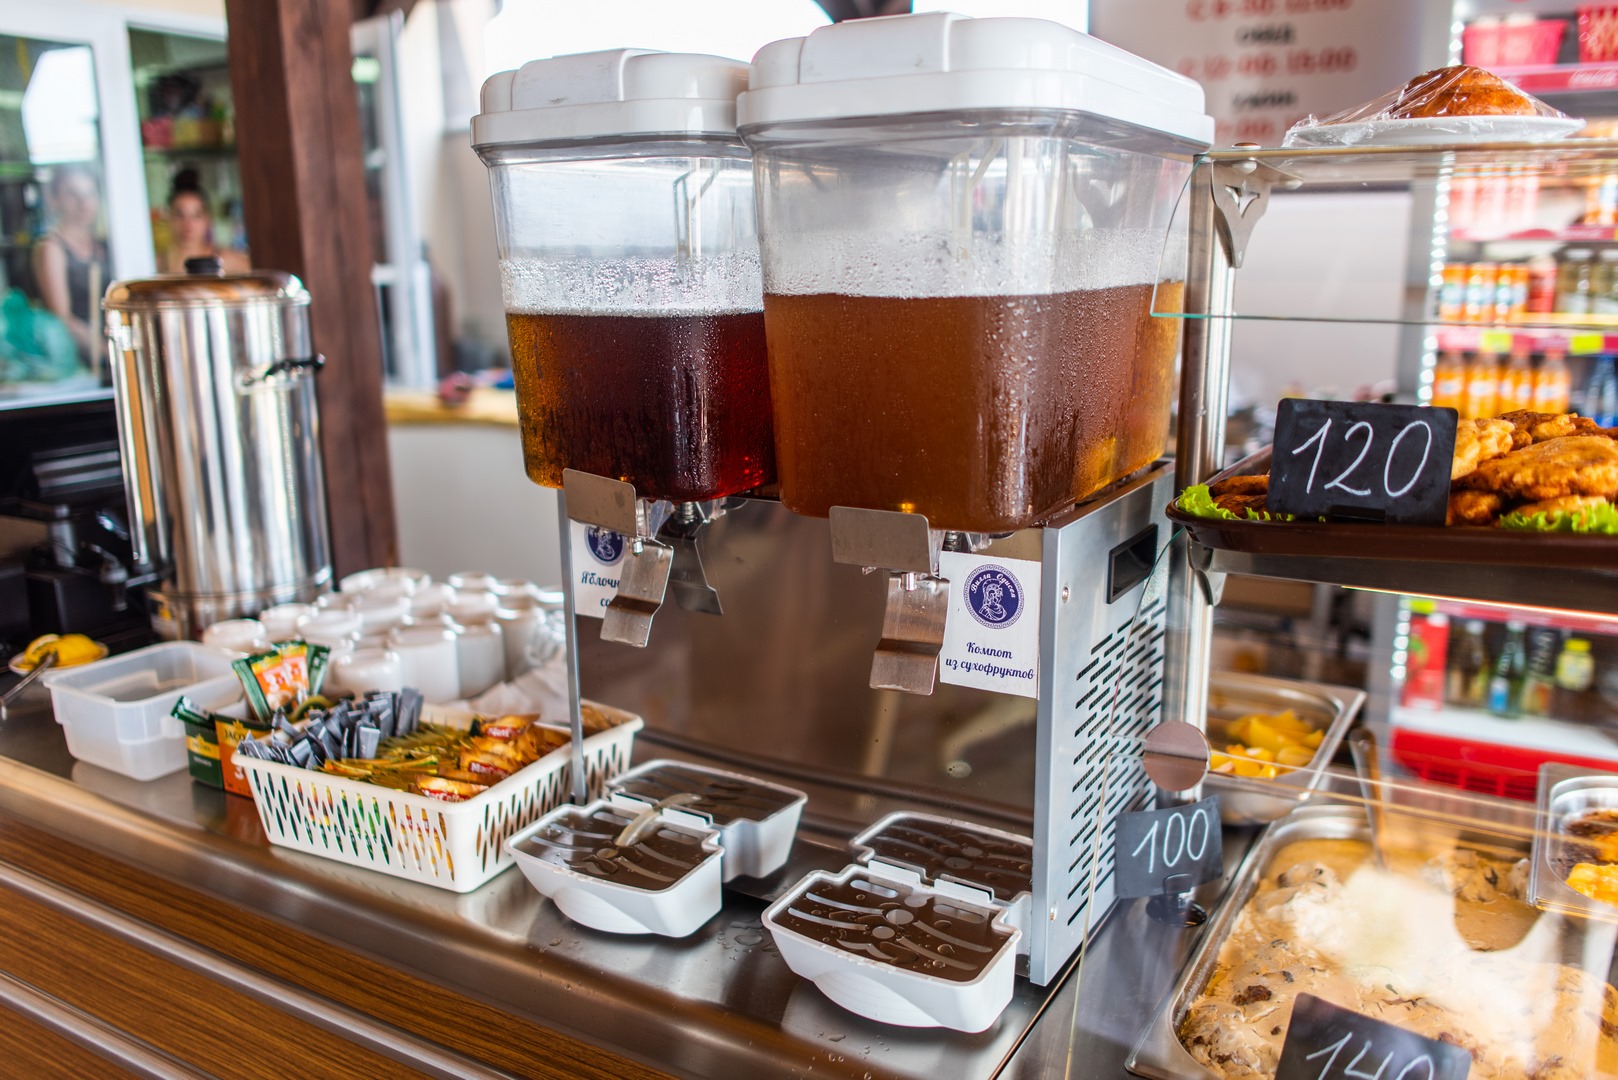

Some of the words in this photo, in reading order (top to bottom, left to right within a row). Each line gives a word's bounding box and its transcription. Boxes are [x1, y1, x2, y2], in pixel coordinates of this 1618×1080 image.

[1291, 418, 1433, 498] 120
[581, 571, 620, 589] Яблочн
[970, 573, 992, 594] Вилла
[600, 598, 610, 607] со
[966, 642, 1013, 659] Компот
[945, 658, 958, 670] из
[961, 661, 1035, 680] сухофруктов
[225, 730, 246, 741] JACO
[1131, 808, 1211, 874] 100
